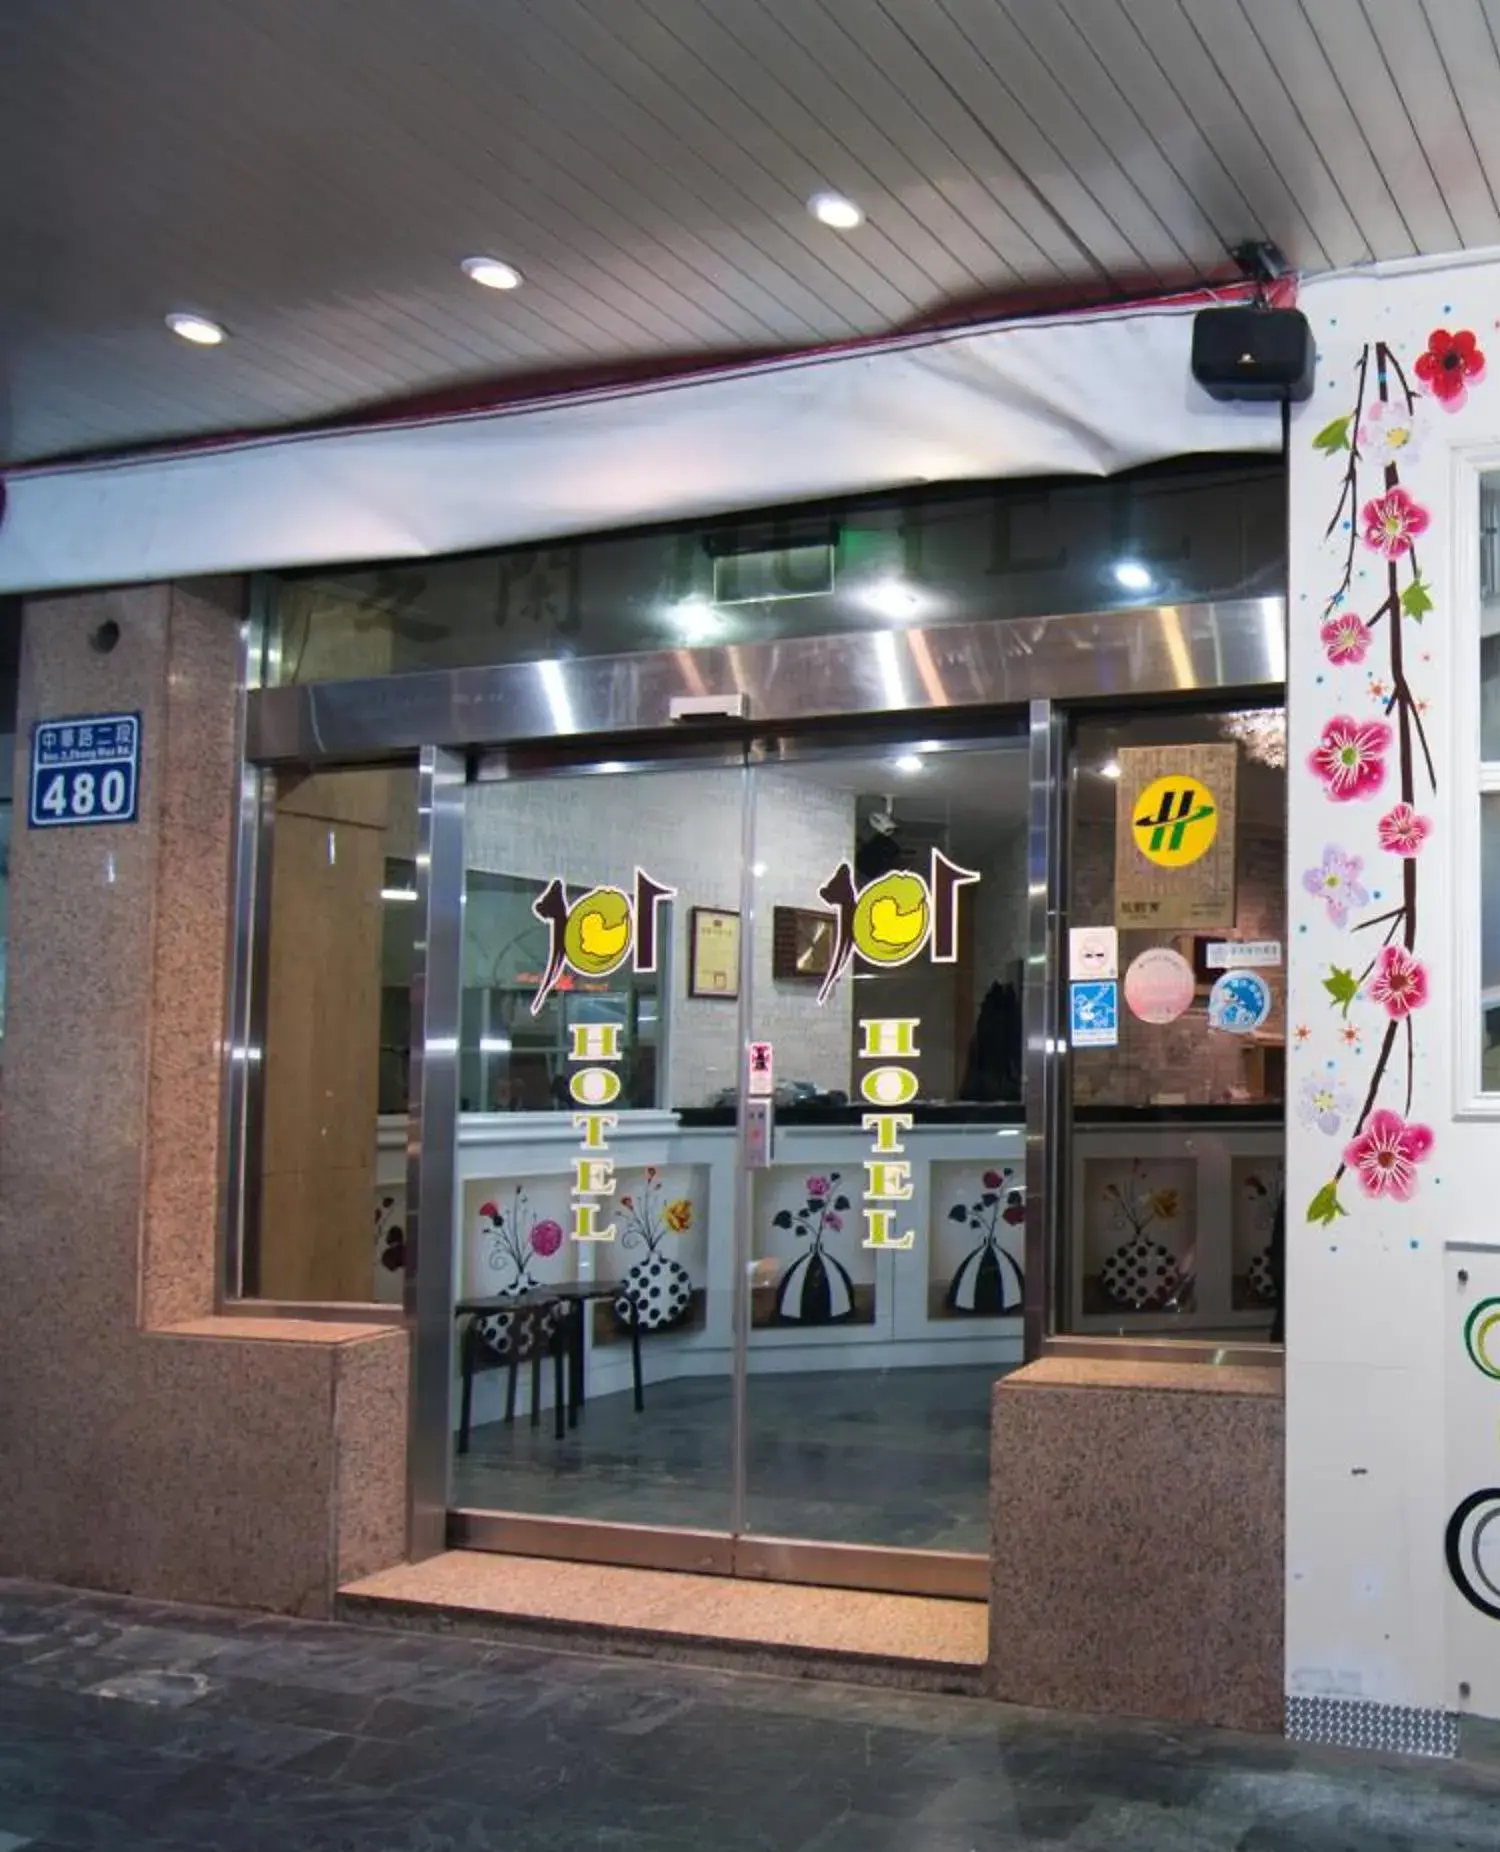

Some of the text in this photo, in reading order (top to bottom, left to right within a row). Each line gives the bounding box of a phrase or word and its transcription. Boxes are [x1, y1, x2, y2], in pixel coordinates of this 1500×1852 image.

[42, 769, 126, 816] 480
[567, 1023, 624, 1242] HOTEL
[858, 1017, 922, 1250] HOTEL
